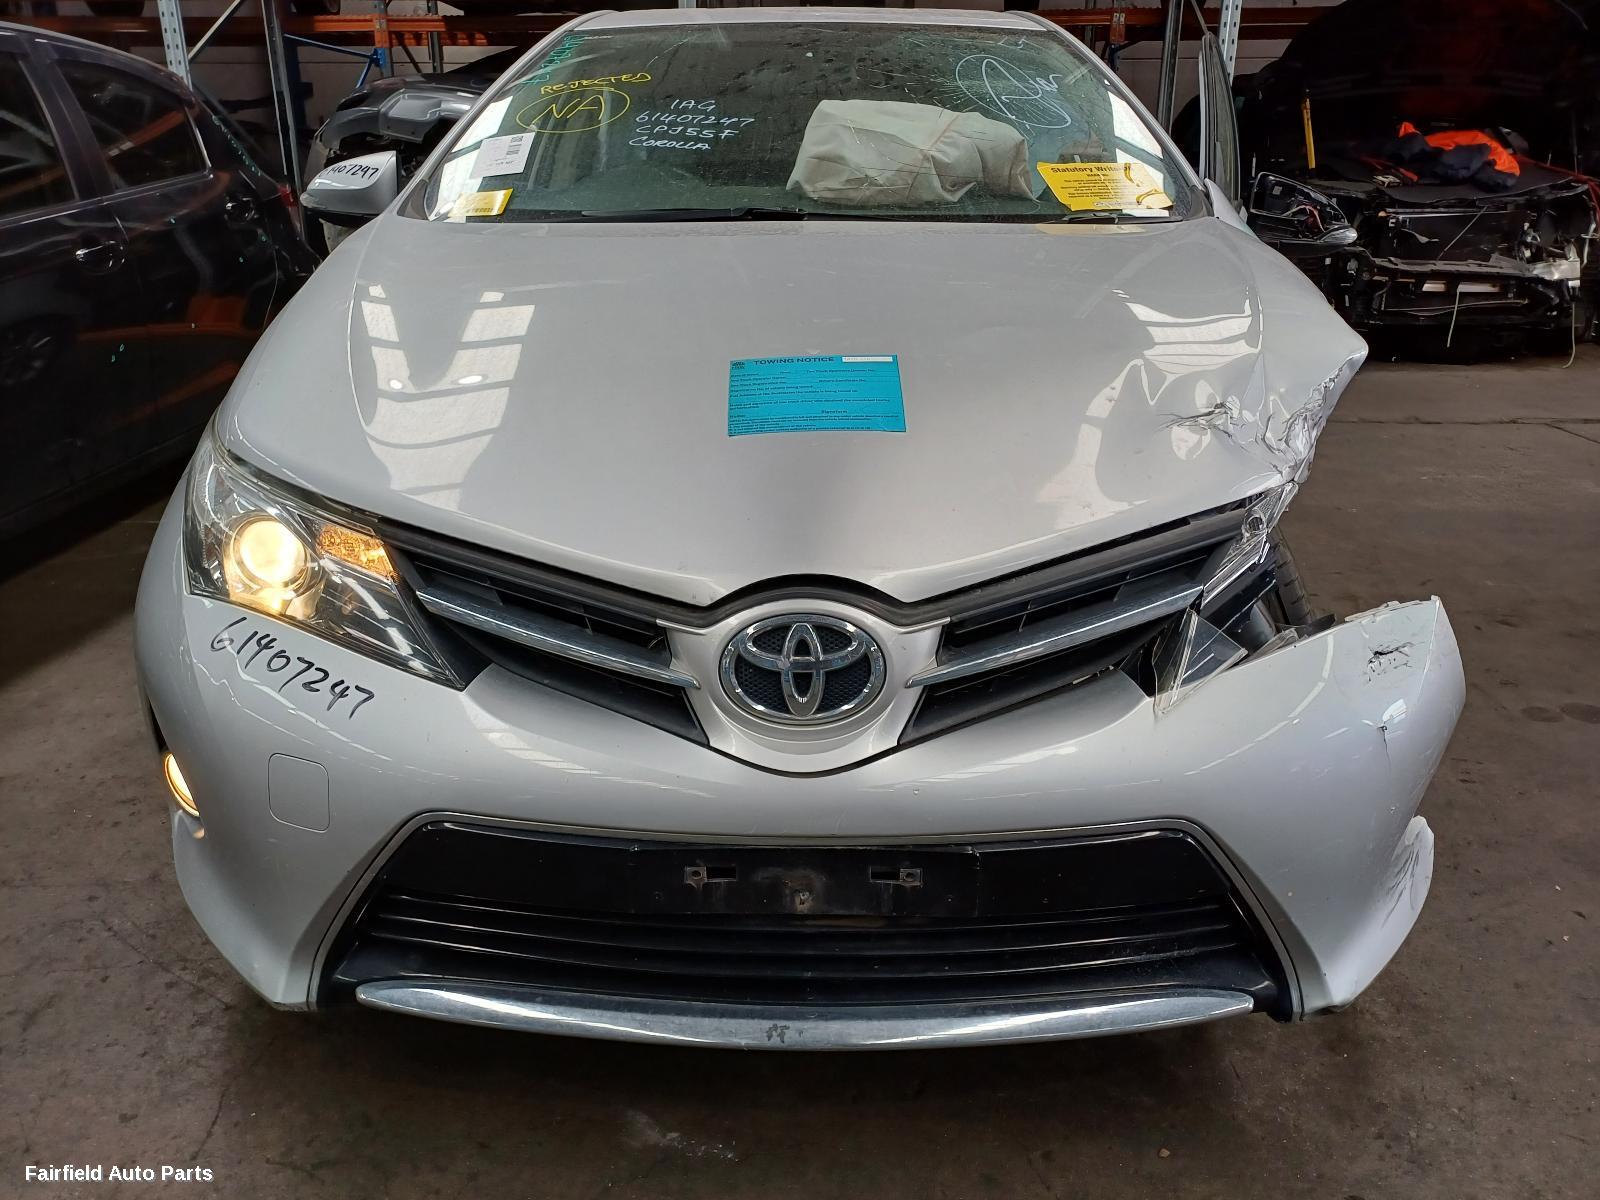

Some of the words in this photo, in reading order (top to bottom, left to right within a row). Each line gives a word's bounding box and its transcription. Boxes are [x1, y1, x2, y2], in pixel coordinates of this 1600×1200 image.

[540, 72, 652, 95] REJECTED
[531, 94, 605, 124] NA
[670, 99, 717, 112] IAG
[635, 110, 755, 127] 61407247
[628, 136, 711, 150] COROLLA
[753, 358, 794, 366] TOWING
[210, 616, 375, 720] 61407247
